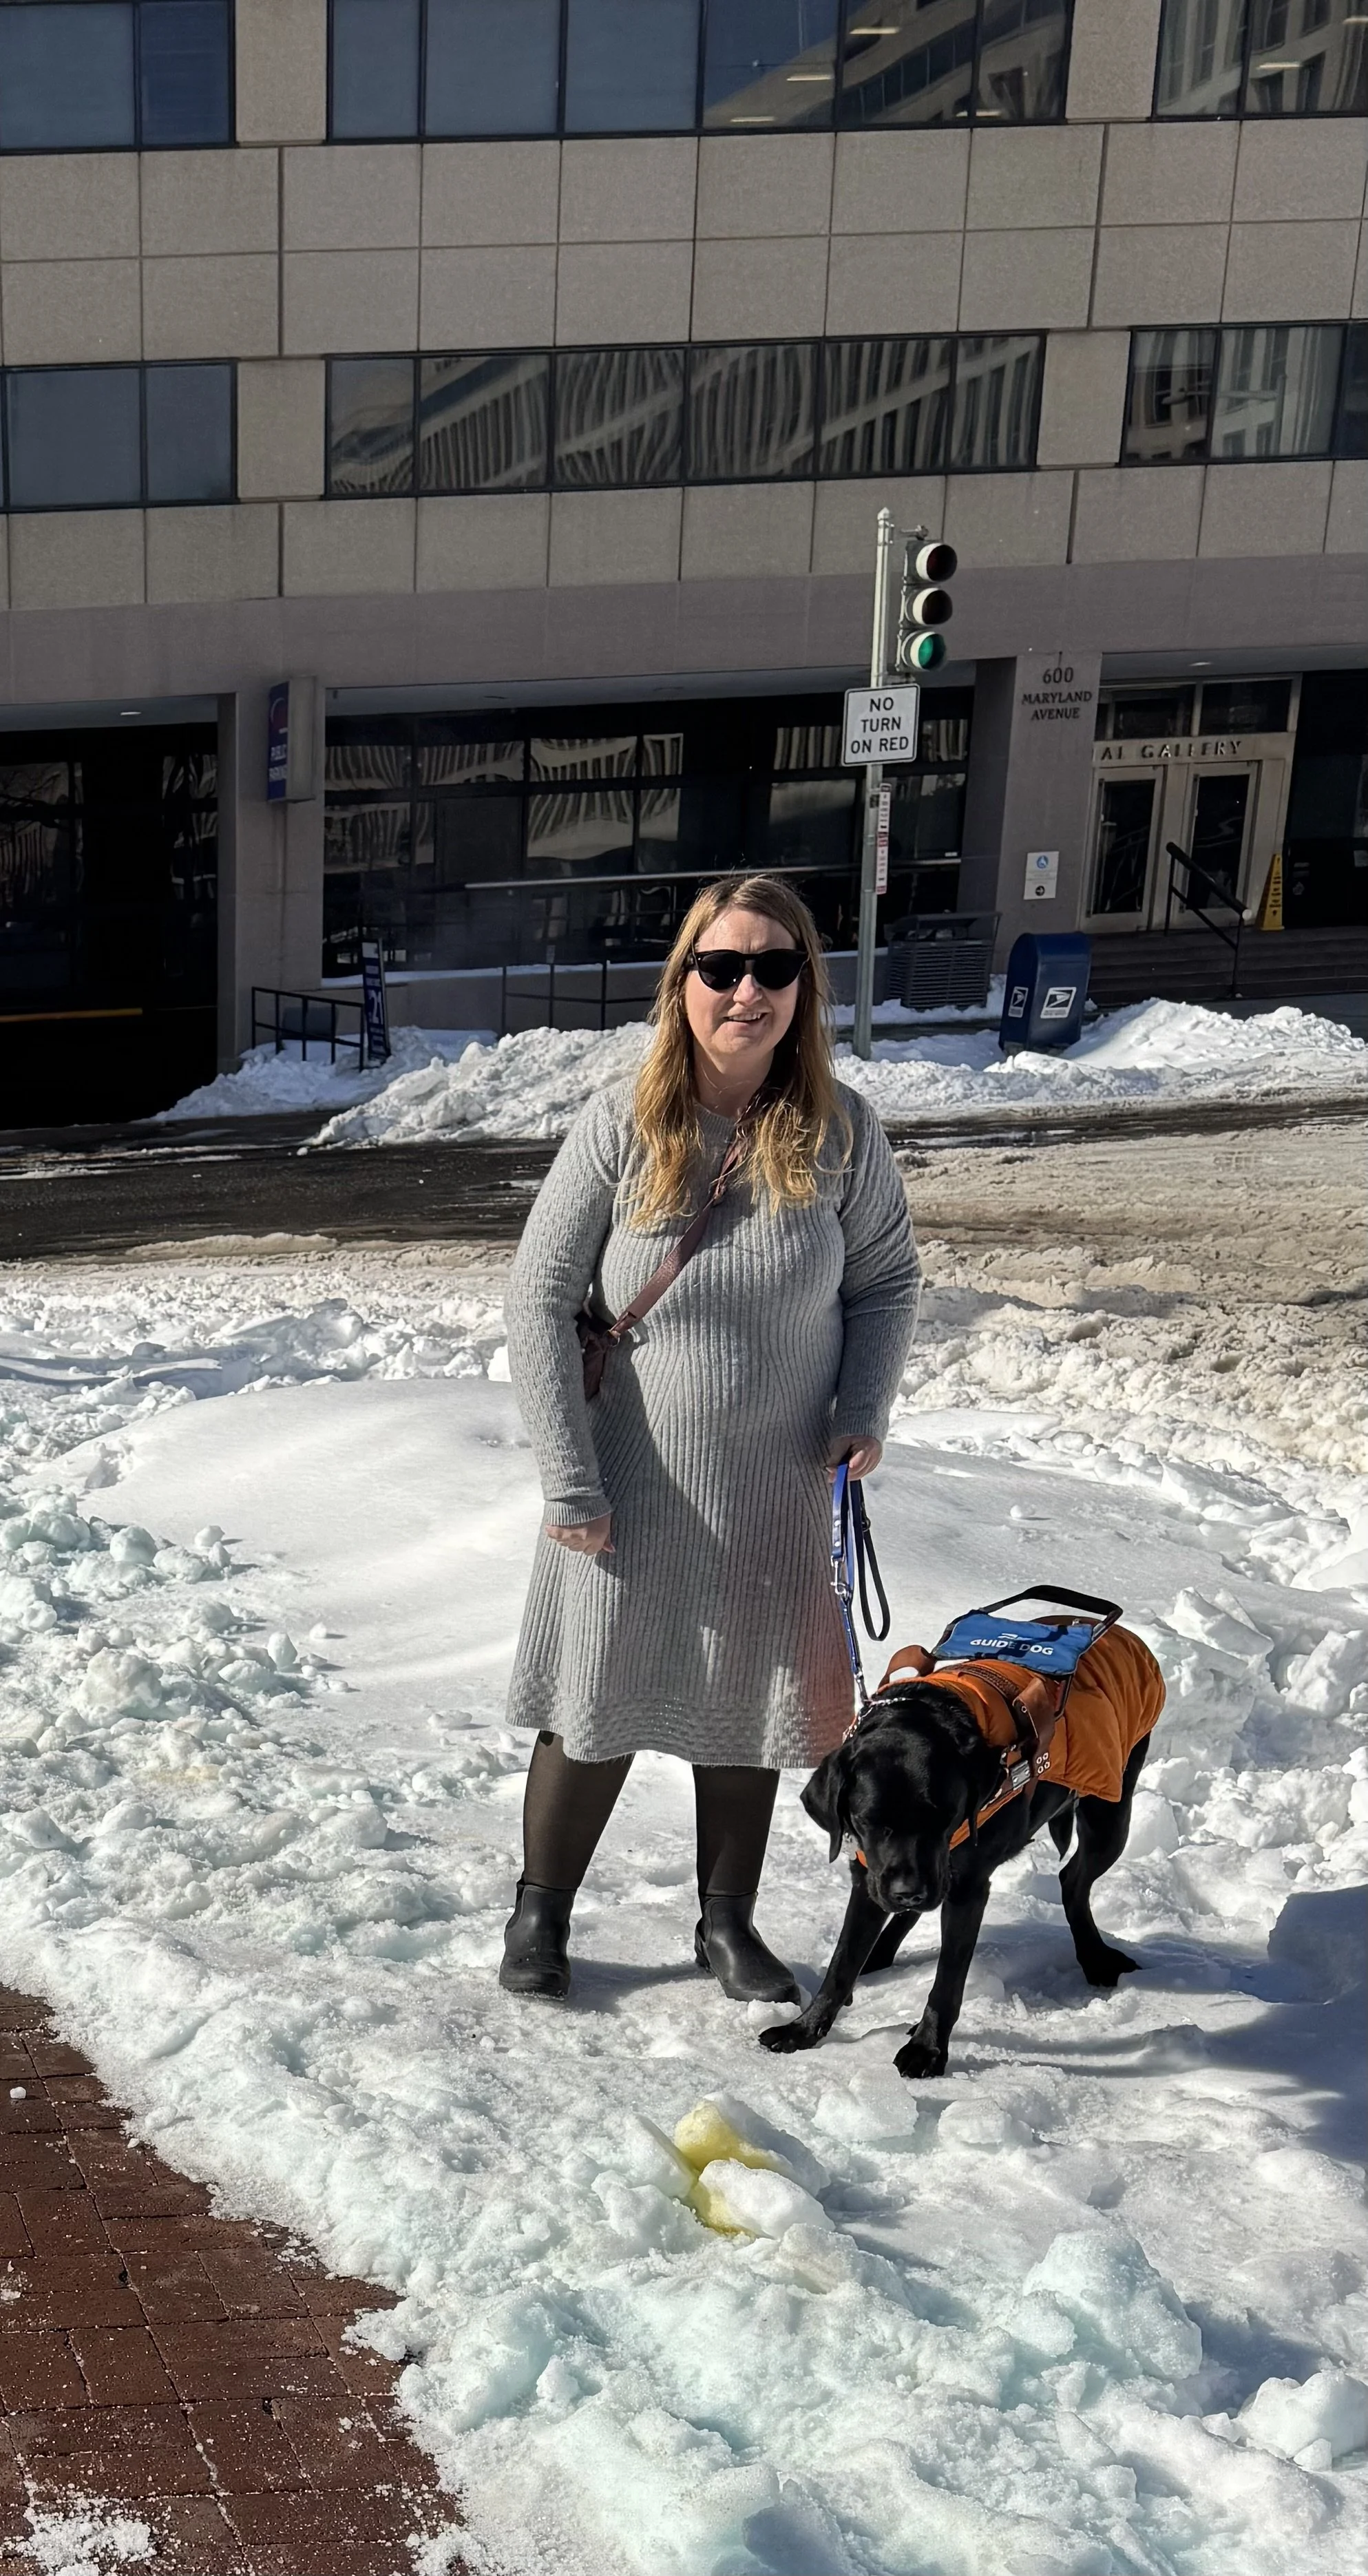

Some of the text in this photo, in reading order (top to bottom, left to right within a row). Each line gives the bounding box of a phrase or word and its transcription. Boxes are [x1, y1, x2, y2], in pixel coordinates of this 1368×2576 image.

[1042, 667, 1074, 684] 600
[869, 697, 894, 713] NO
[1022, 691, 1093, 705] MARYLAND
[1031, 707, 1080, 721] AVENUE
[860, 716, 901, 733] TURN
[850, 736, 909, 755] ON RED
[1141, 740, 1241, 760] GALLERY
[969, 1639, 1054, 1655] GUIDE DOG
